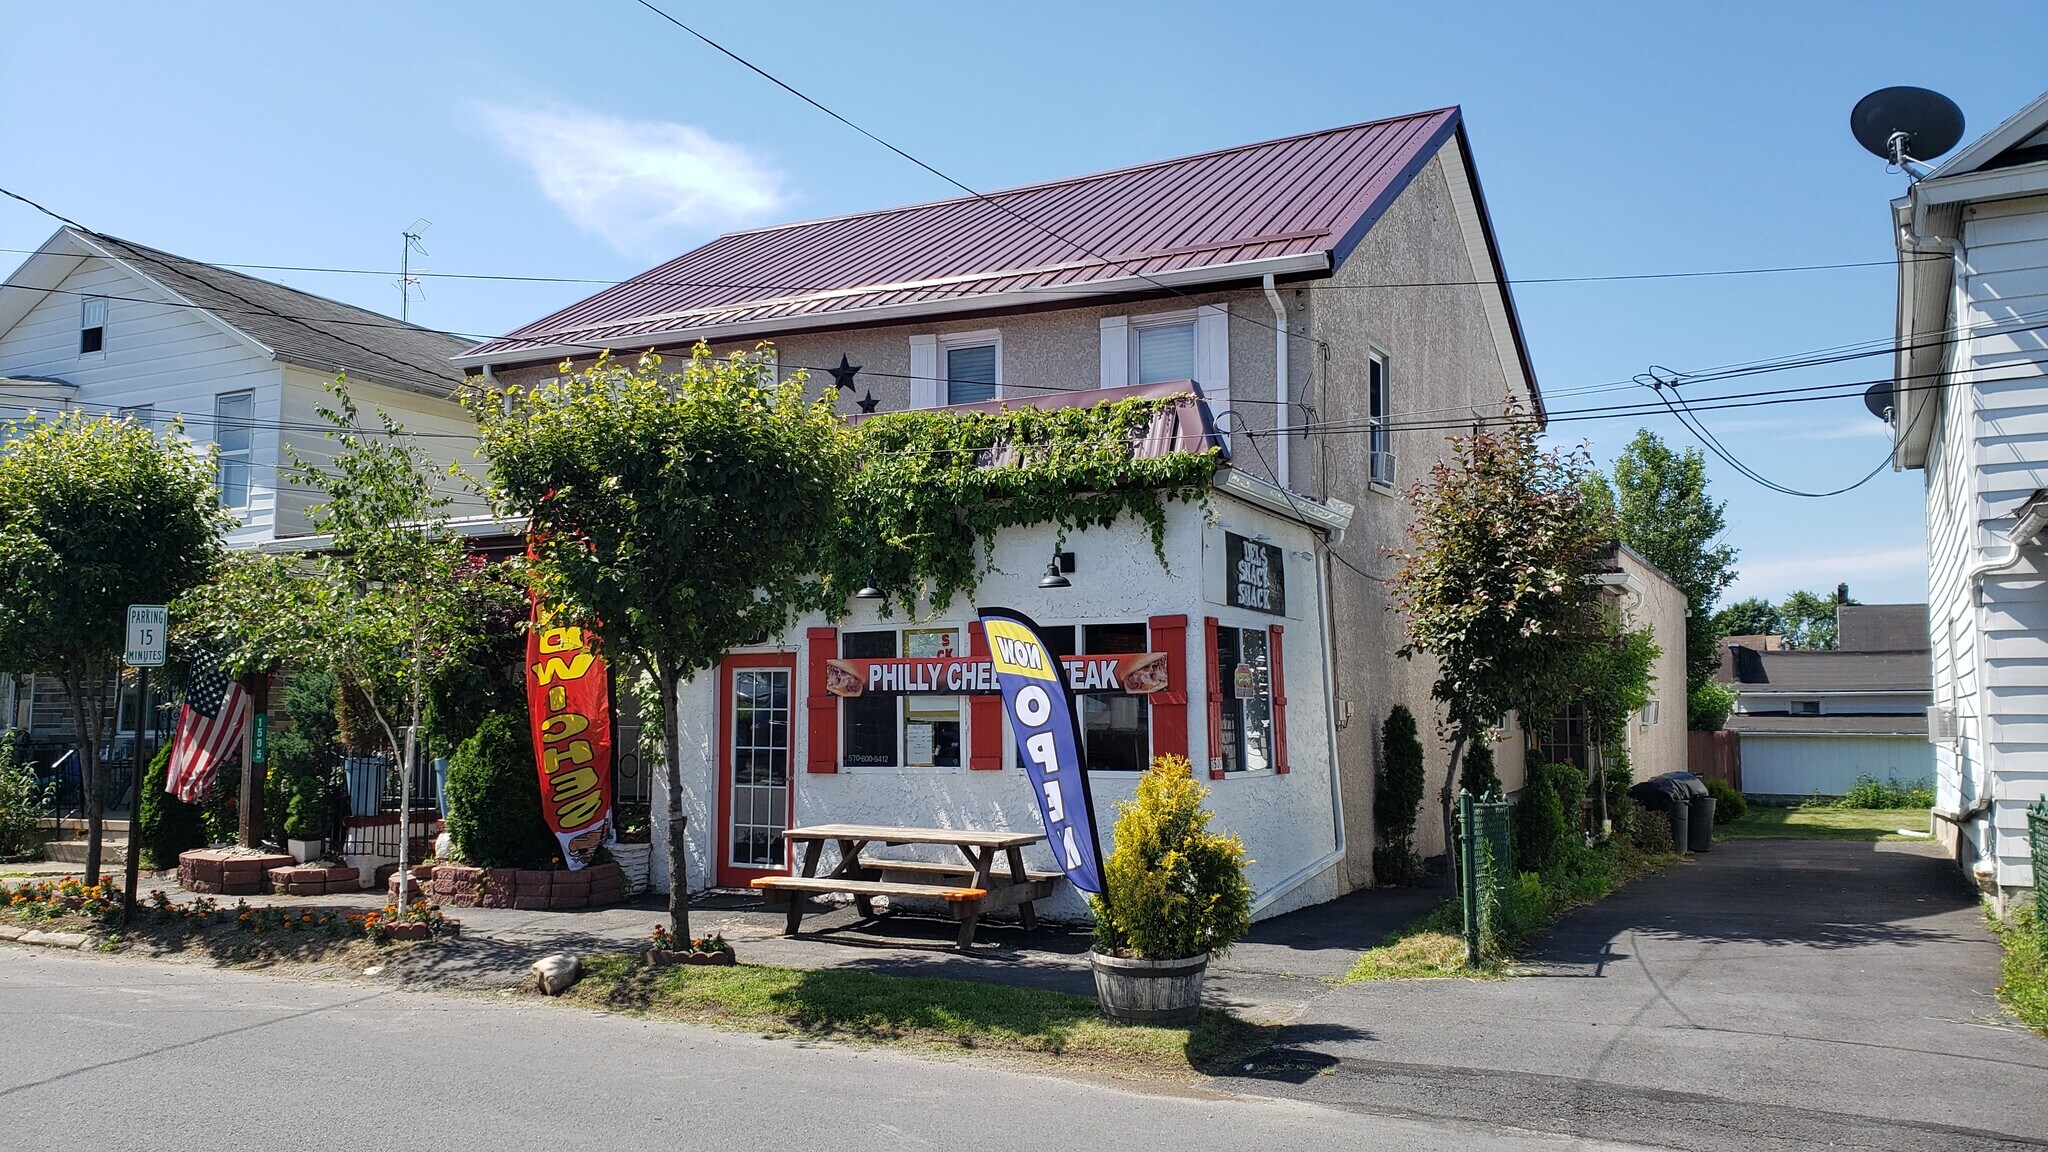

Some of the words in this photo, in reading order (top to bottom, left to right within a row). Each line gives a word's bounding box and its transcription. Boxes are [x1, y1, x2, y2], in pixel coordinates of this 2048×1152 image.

[1237, 583, 1271, 610] SHACK
[131, 609, 164, 624] PARKING
[140, 629, 153, 646] 15
[128, 650, 162, 662] MINUTES
[868, 662, 943, 691] PHILLY
